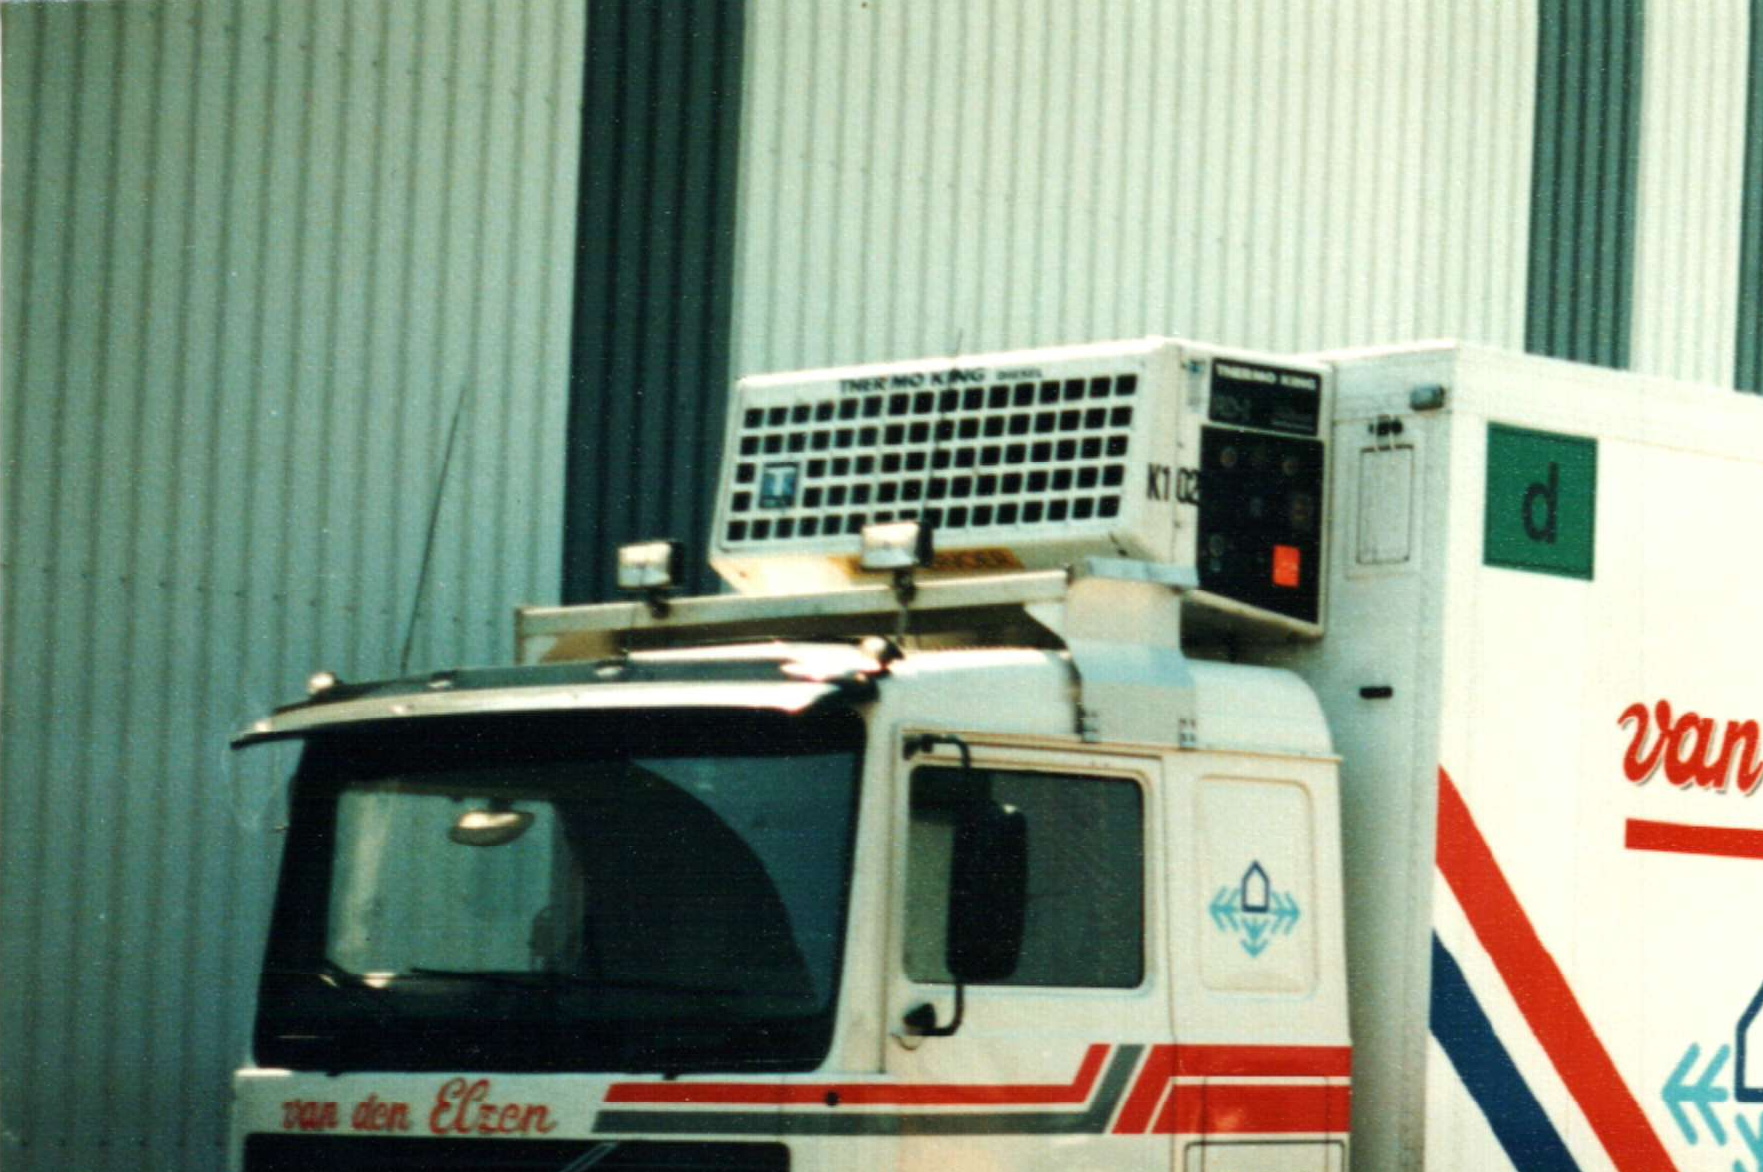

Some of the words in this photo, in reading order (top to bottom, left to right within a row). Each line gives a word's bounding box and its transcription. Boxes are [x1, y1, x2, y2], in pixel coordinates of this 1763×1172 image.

[931, 368, 986, 386] KING
[280, 1096, 339, 1132] van
[350, 1093, 411, 1132] den
[428, 1077, 559, 1135] Elzen
